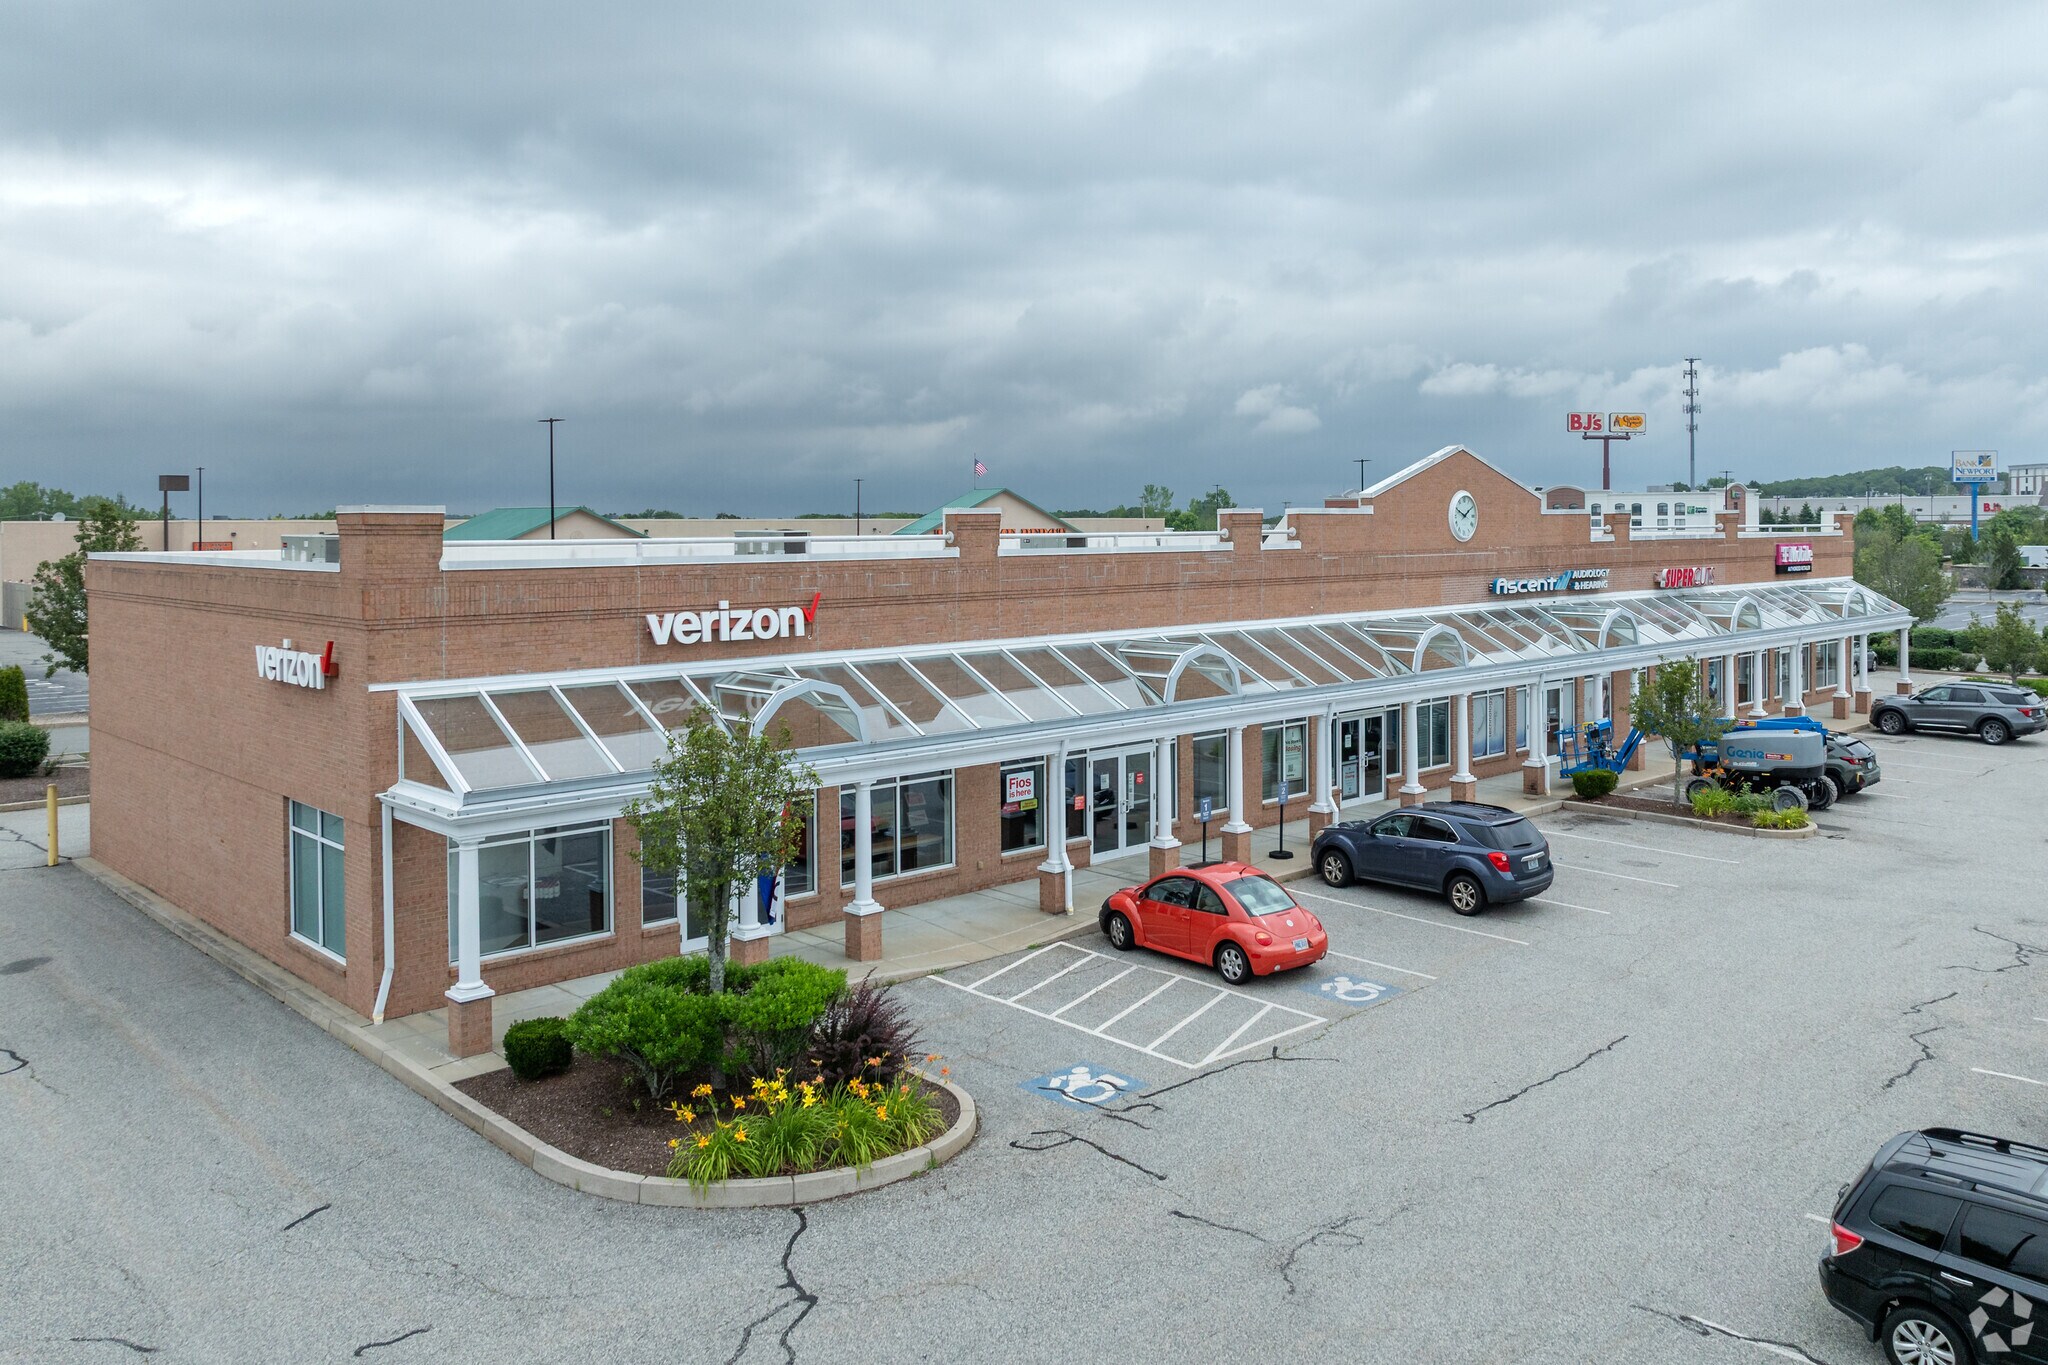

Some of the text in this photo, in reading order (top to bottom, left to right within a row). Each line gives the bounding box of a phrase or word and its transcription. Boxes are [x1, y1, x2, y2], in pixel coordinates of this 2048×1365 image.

[1570, 414, 1602, 430] BJ's
[1572, 569, 1610, 579] AUDIOLOGY
[1495, 577, 1557, 594] Ascent
[1574, 580, 1608, 590] & HEARING
[646, 600, 805, 645] verizon
[255, 639, 325, 689] verizon
[1726, 746, 1764, 759] Genie
[1009, 777, 1031, 790] Fios
[1009, 789, 1031, 798] is here
[1204, 803, 1208, 811] 1
